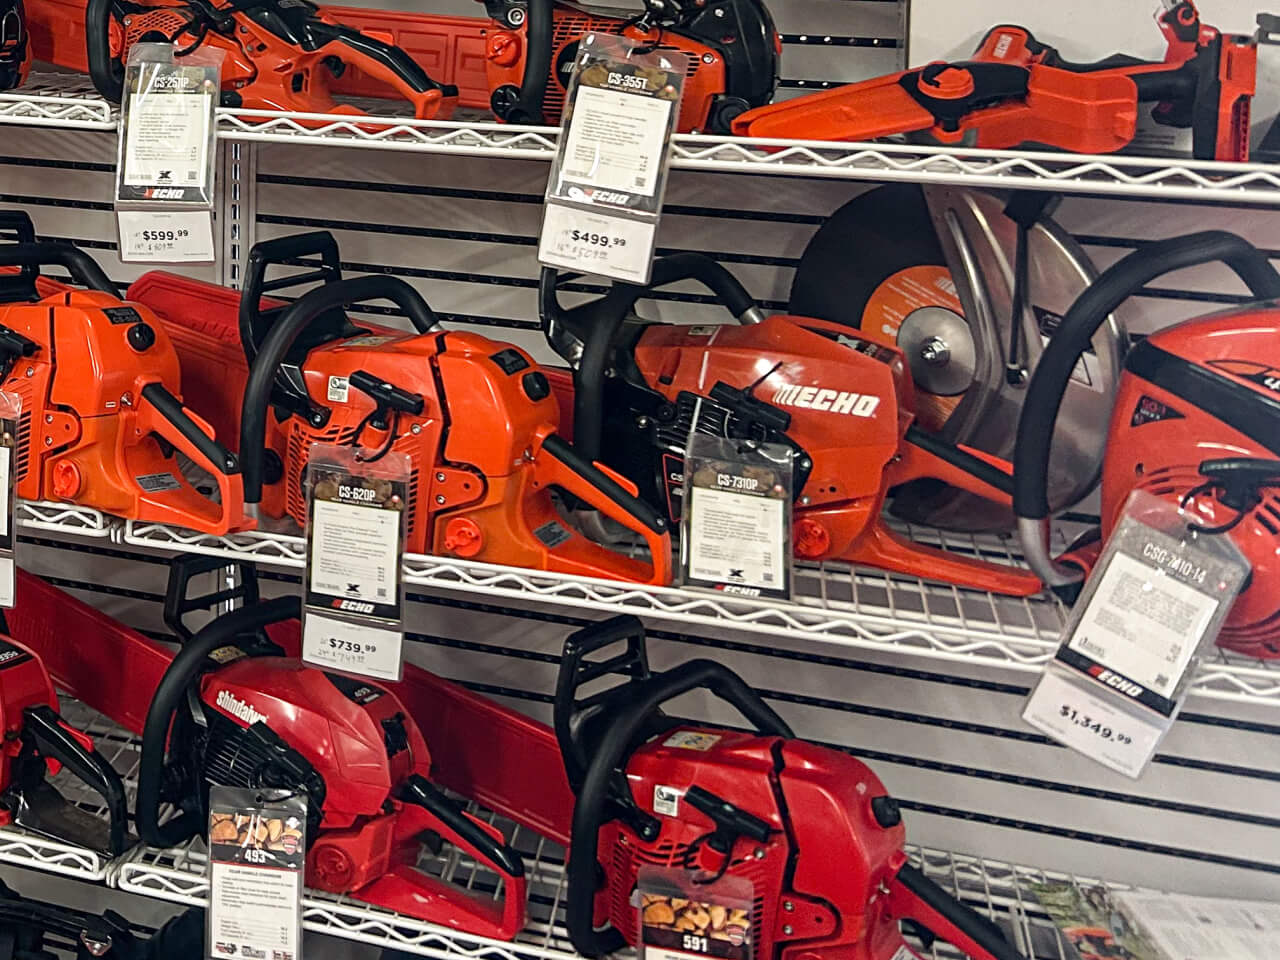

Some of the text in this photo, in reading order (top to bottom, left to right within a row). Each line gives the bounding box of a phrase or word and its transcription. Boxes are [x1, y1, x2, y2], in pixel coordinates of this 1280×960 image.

[608, 72, 648, 88] CS-355T
[152, 189, 184, 199] ECHO
[592, 190, 628, 204] ECHO
[143, 230, 188, 240] $599.99
[572, 230, 626, 248] $499.99
[793, 387, 880, 417] ECHO
[717, 473, 758, 490] CS-7310P
[338, 485, 376, 501] CS-620P
[340, 600, 374, 613] ECHO
[329, 638, 376, 654] $739.99
[1097, 673, 1142, 696] ECHO
[245, 850, 265, 863] 493
[683, 935, 708, 952] 591
